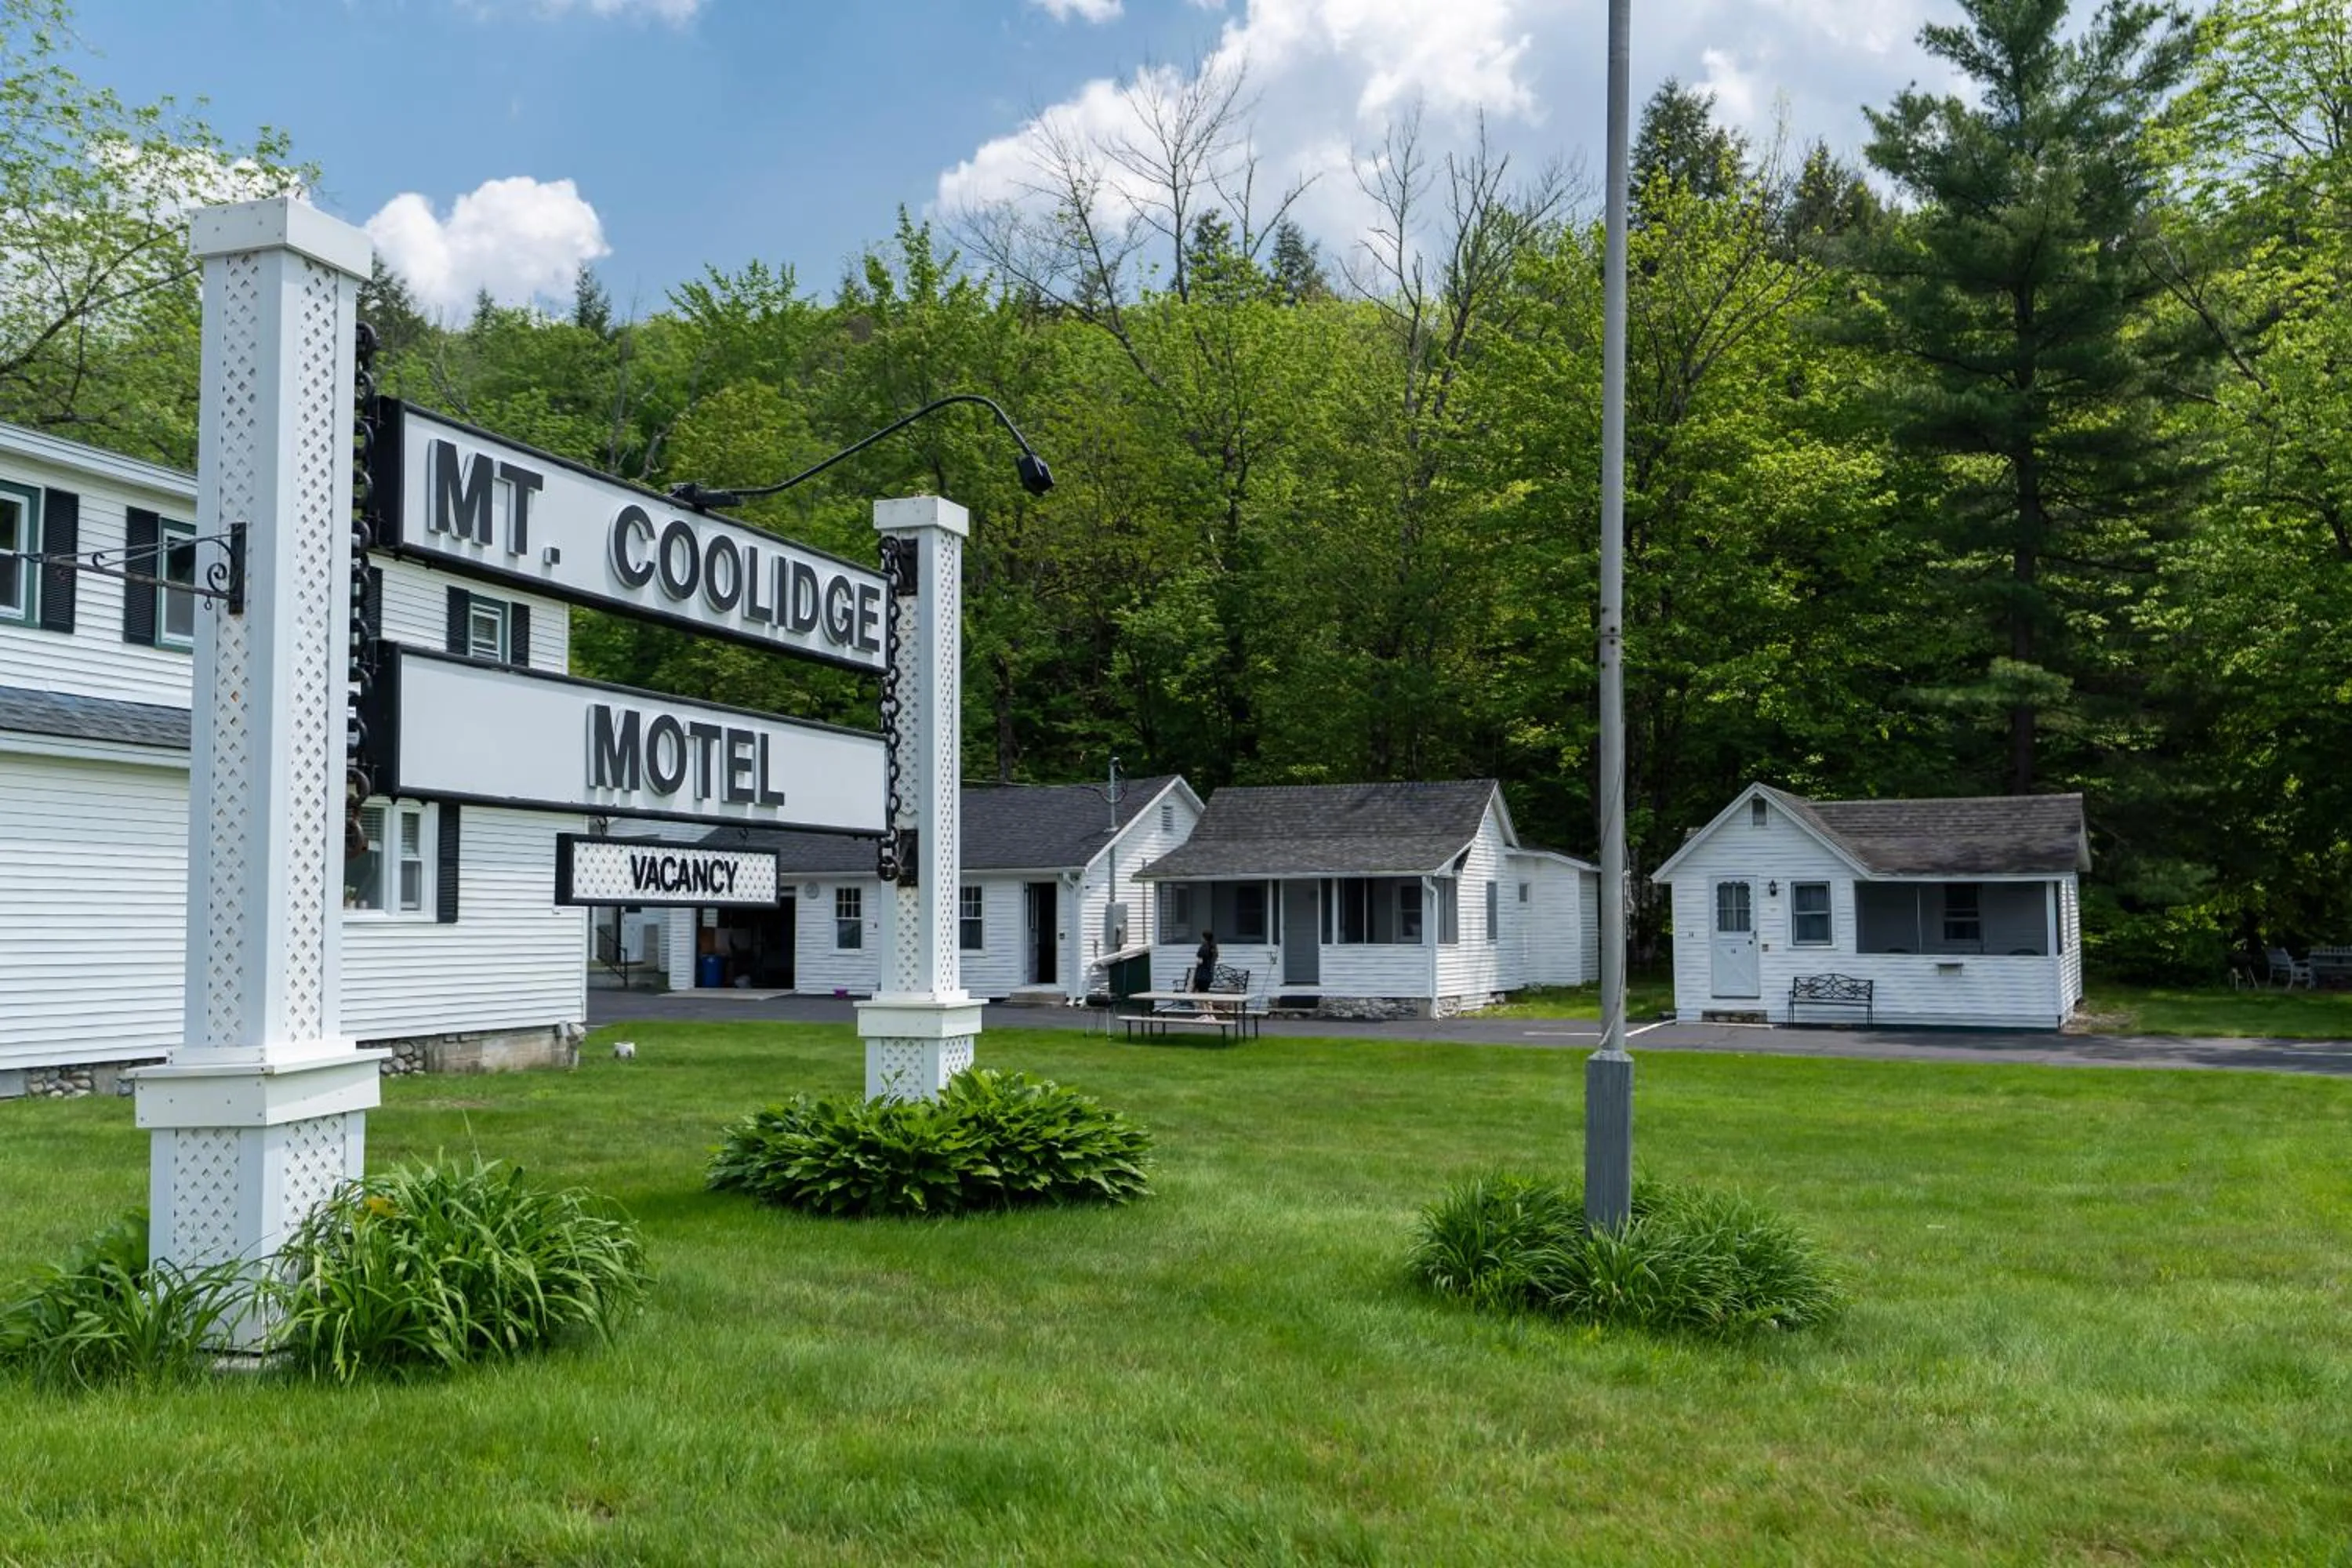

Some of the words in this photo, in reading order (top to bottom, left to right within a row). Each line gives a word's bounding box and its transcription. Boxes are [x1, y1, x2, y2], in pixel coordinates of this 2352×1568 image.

[430, 438, 560, 565] MT.
[608, 504, 880, 652] COOLIDGE
[587, 705, 784, 806] MOTEL
[630, 854, 739, 893] VACANCY
